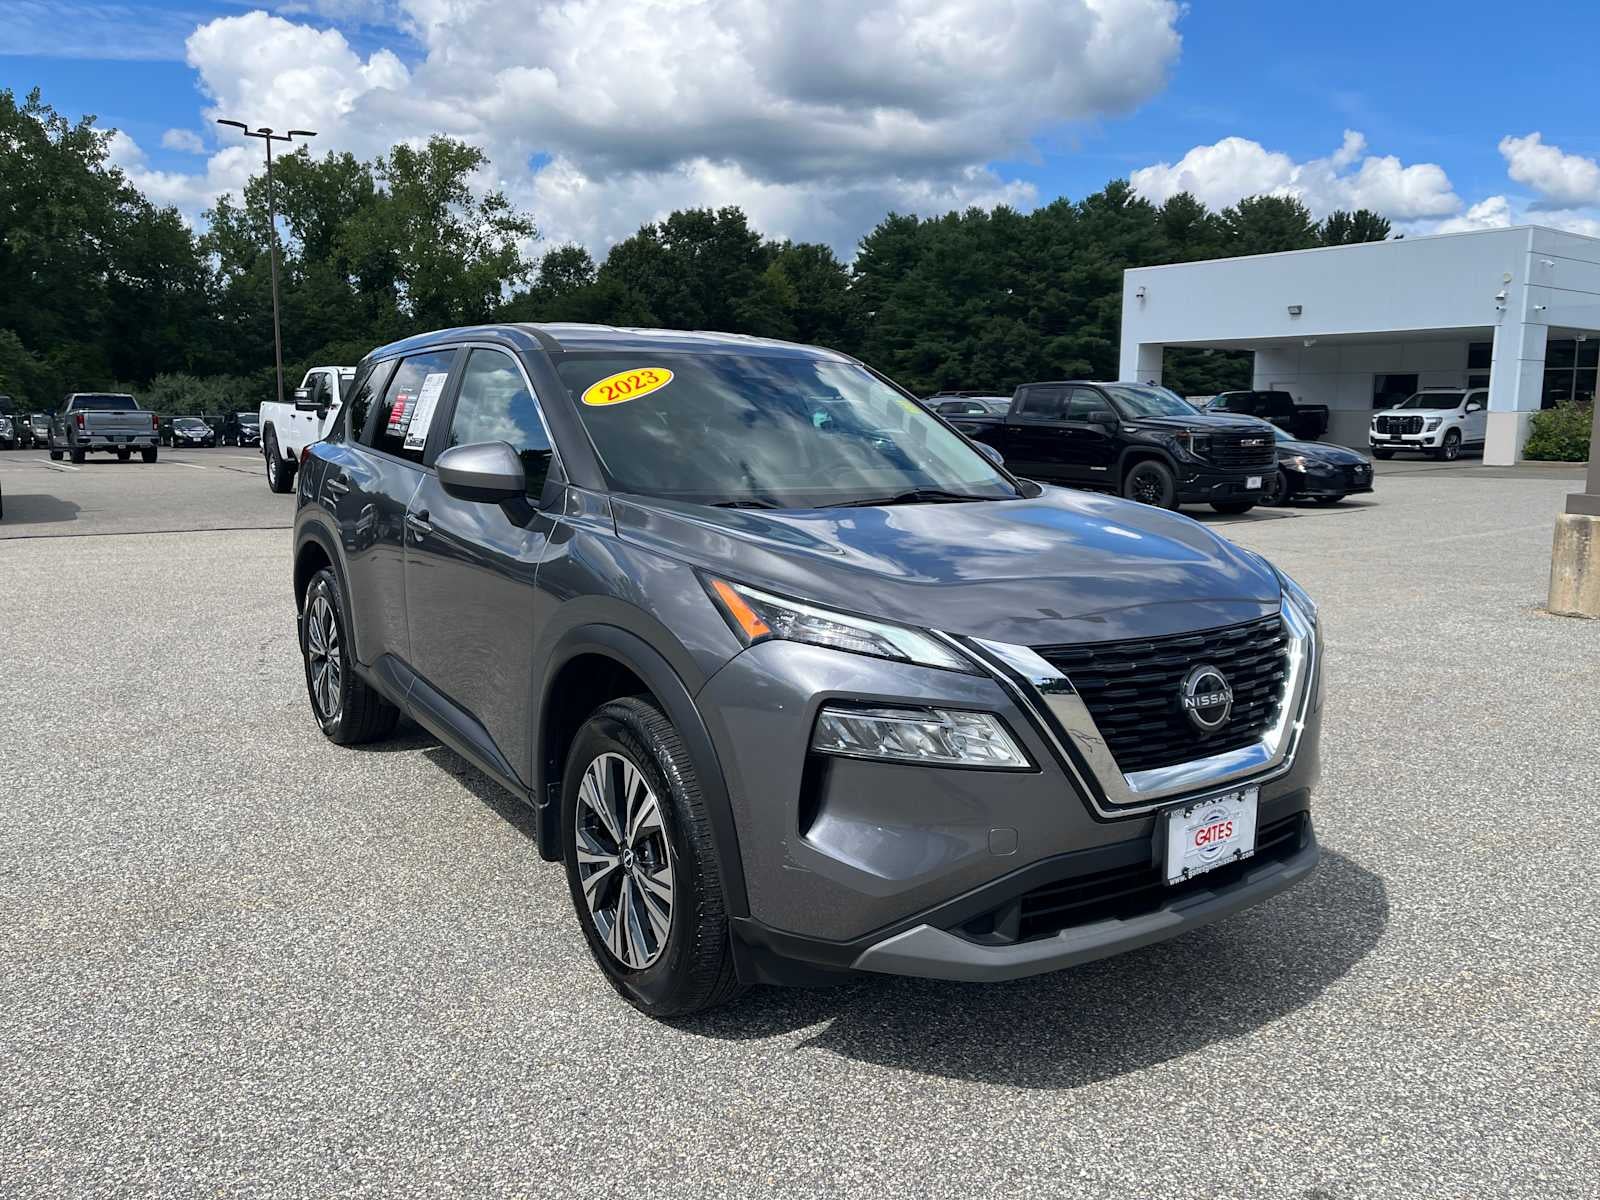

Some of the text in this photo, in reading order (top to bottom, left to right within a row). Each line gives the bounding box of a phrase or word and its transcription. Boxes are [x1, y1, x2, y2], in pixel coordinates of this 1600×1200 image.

[600, 371, 659, 401] 2023
[1184, 691, 1232, 708] NISSAN
[1195, 821, 1233, 846] GATES
